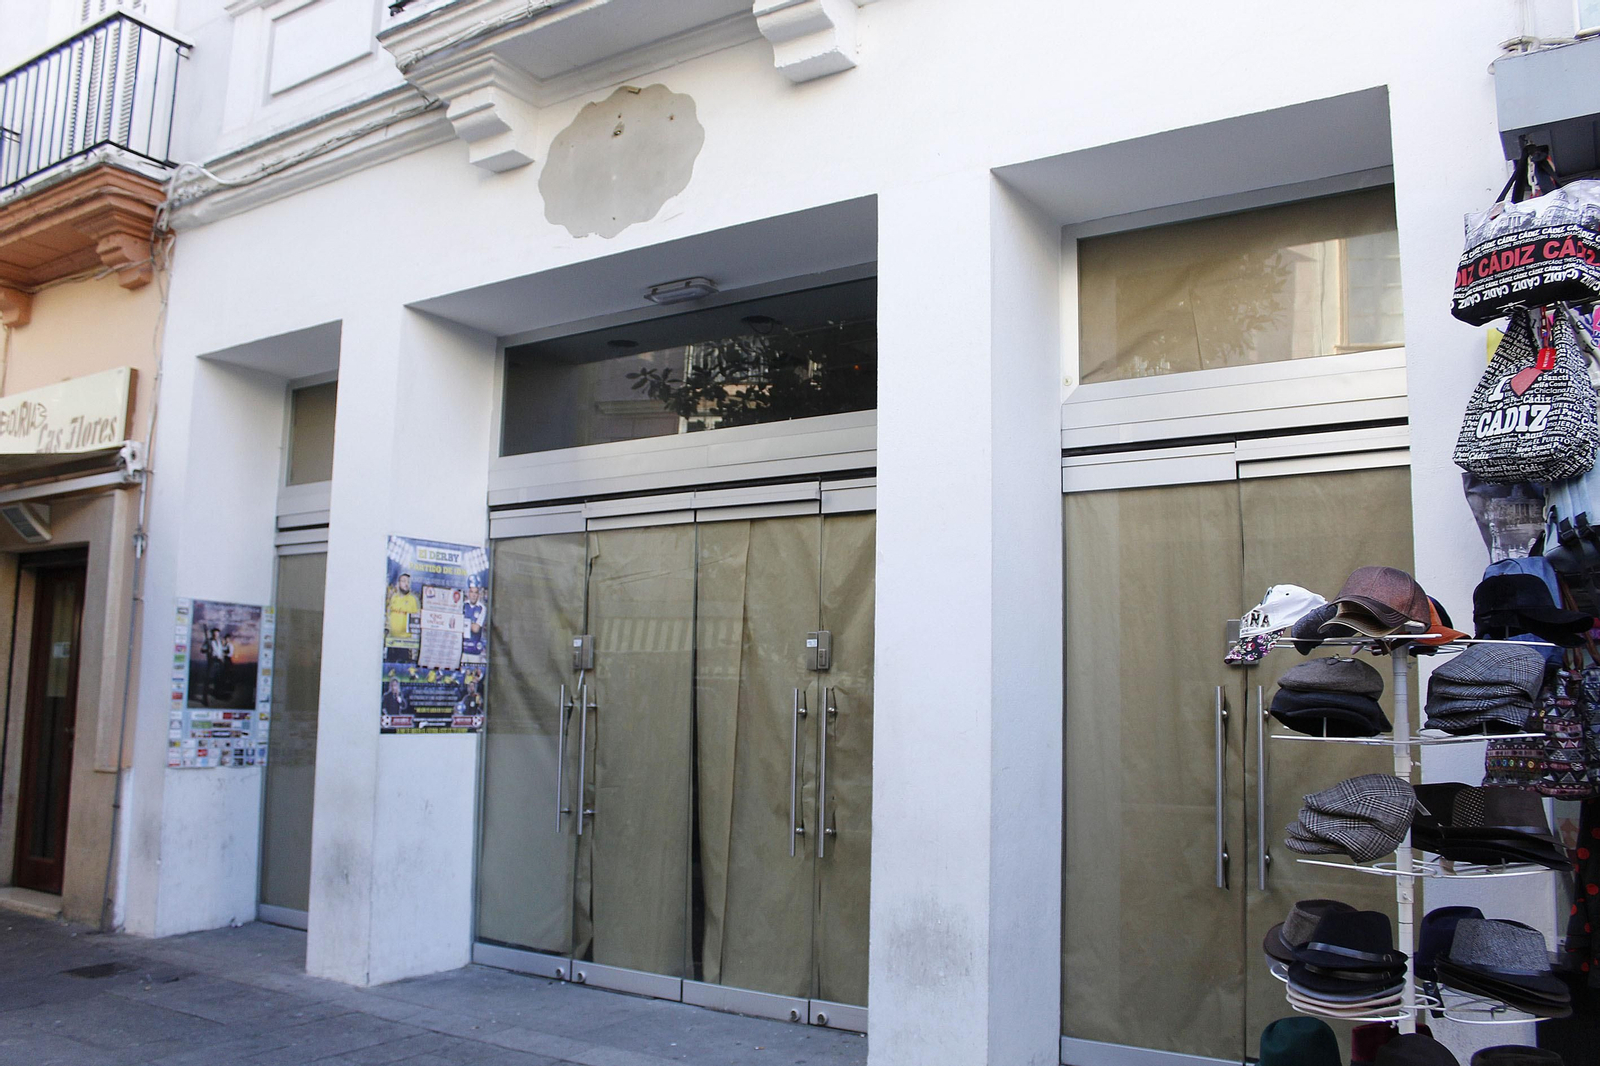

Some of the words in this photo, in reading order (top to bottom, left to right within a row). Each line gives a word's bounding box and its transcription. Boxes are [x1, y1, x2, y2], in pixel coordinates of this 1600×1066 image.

[1497, 234, 1518, 245] CÁDIZ
[1518, 229, 1541, 241] CÁDIZ
[1542, 225, 1567, 236] CÁDIZ
[1478, 244, 1535, 277] CÁDIZ
[1544, 264, 1562, 273] CÁDIZ
[1482, 284, 1509, 301] CÁDIZ
[1511, 275, 1540, 292] CÁDIZ
[1543, 268, 1579, 284] CÁDIZ
[1488, 373, 1518, 403] I
[1523, 394, 1552, 403] Cádiz
[1476, 402, 1551, 438] CÁDIZ
[1558, 420, 1579, 431] JEREZ
[66, 415, 117, 450] Flores
[1542, 436, 1570, 445] PUERTO
[1469, 451, 1489, 460] Cádiz
[1490, 458, 1513, 466] PUERTO
[1520, 464, 1546, 473] Cádiz
[430, 551, 460, 564] DERBY
